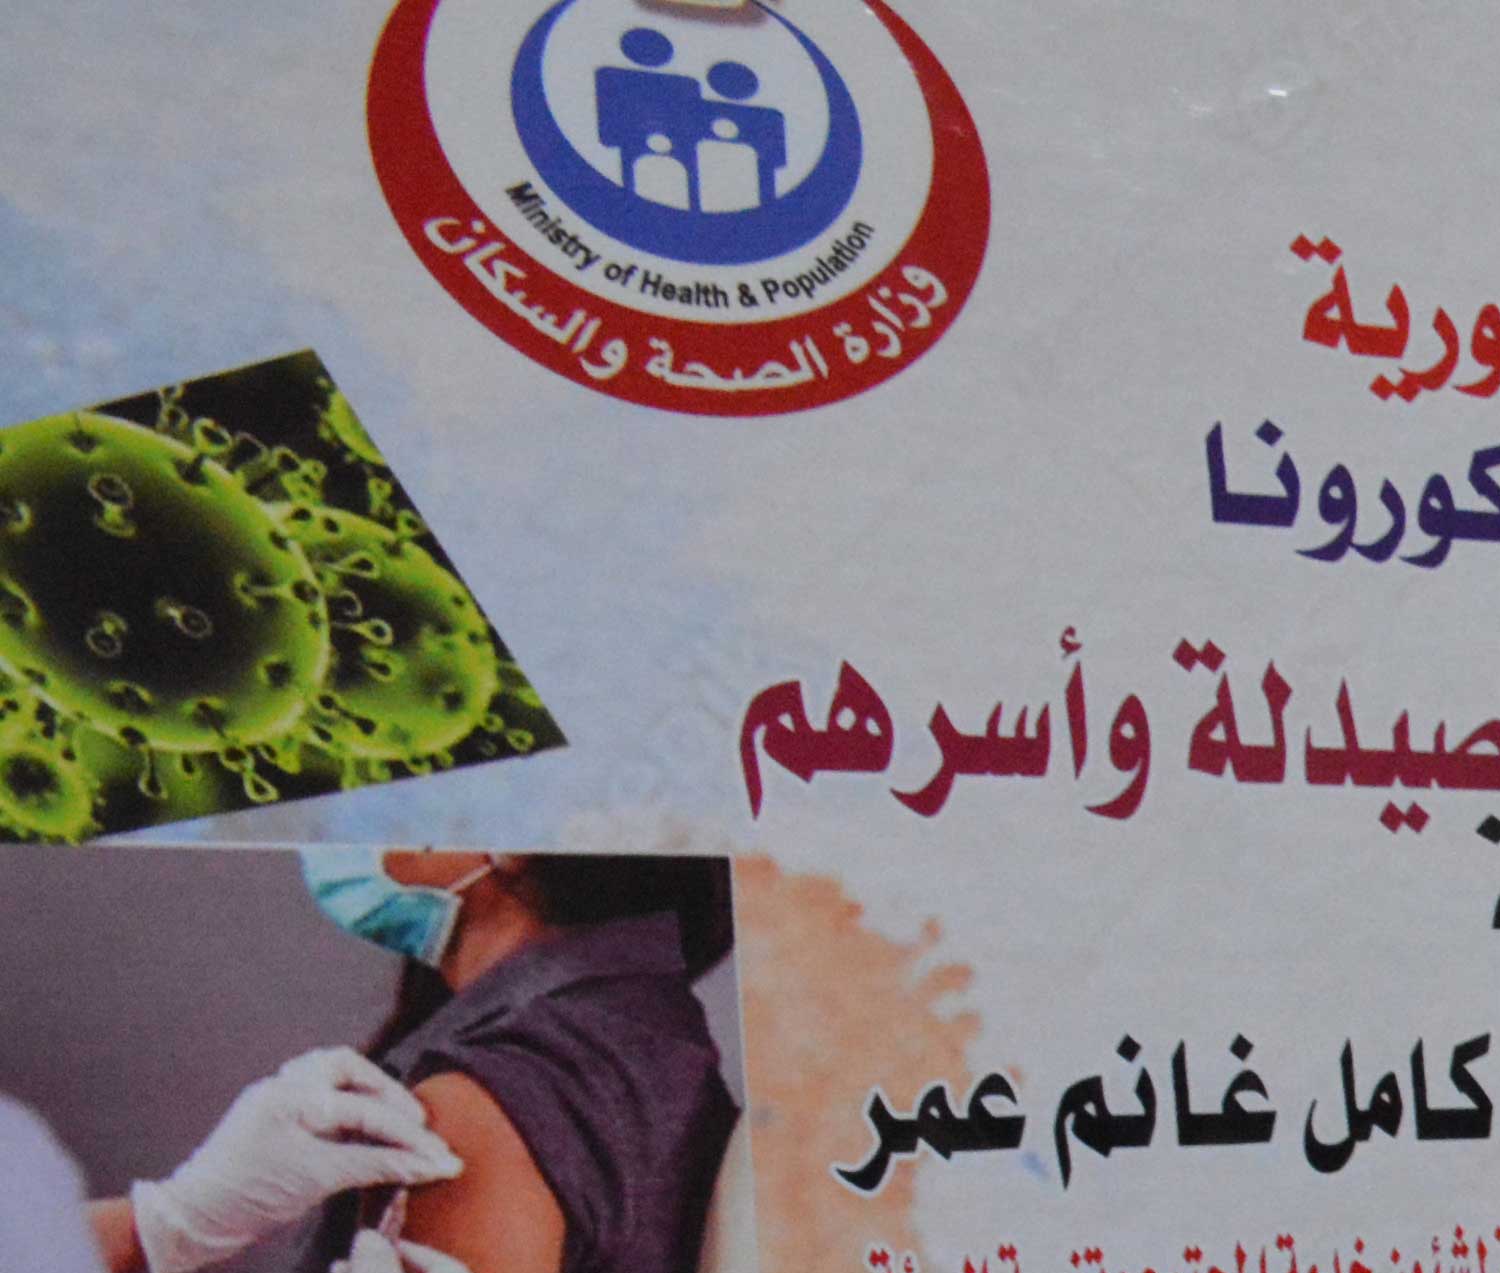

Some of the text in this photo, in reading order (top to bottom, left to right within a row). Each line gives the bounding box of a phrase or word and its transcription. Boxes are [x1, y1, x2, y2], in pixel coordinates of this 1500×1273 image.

[425, 213, 948, 393] وزارة الصحة والسكان
[506, 180, 875, 311] Ministry of Health & Population
[742, 623, 1150, 818] وأسرهم
[838, 1074, 1025, 1190] عمر
[1055, 1035, 1276, 1187] غانم
[1305, 1034, 1492, 1173] كامل
